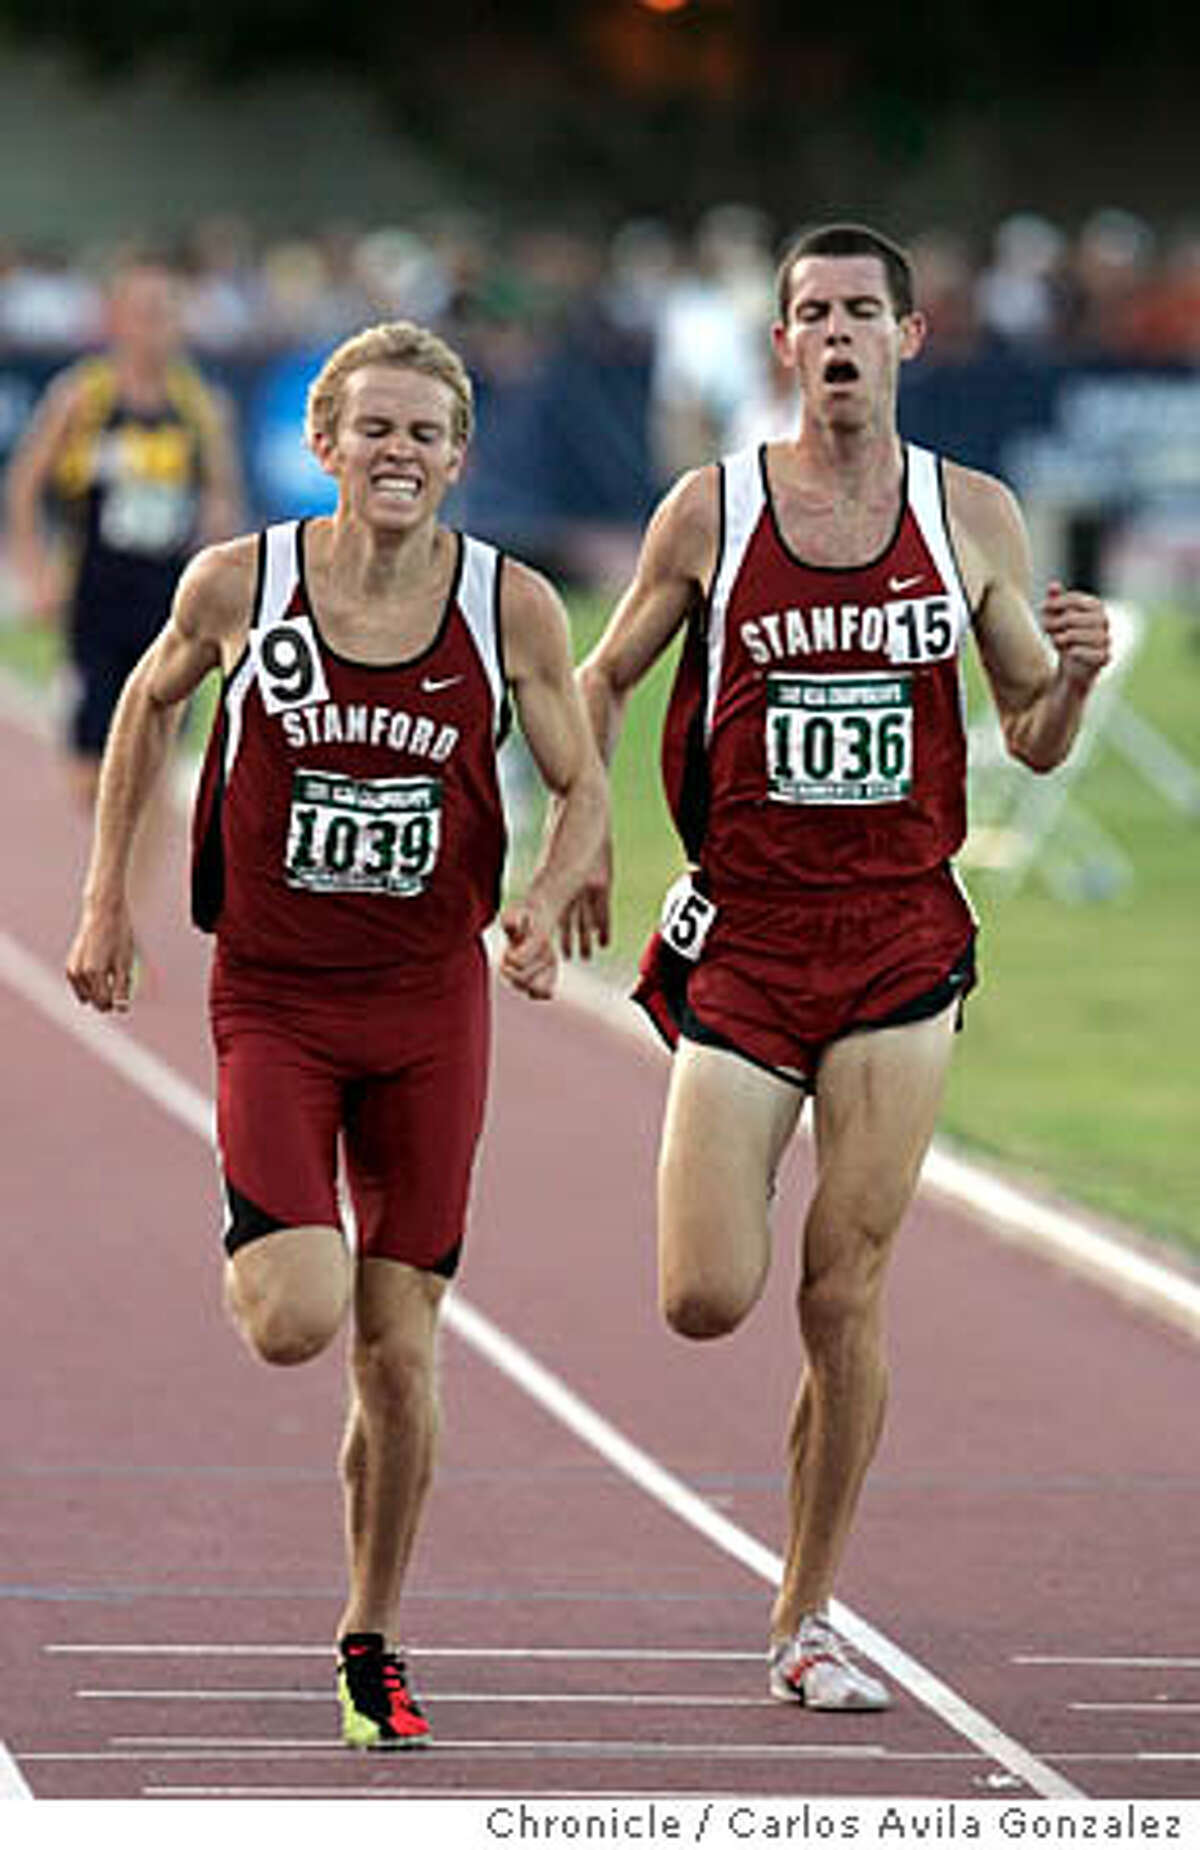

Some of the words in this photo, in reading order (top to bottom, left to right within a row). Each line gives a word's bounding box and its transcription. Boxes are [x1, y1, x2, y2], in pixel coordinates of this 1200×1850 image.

[740, 604, 891, 664] STANFO
[895, 601, 951, 659] 15
[260, 626, 314, 702] 9
[281, 704, 460, 762] STANFORD
[771, 714, 905, 781] 1036
[291, 808, 432, 875] 1039
